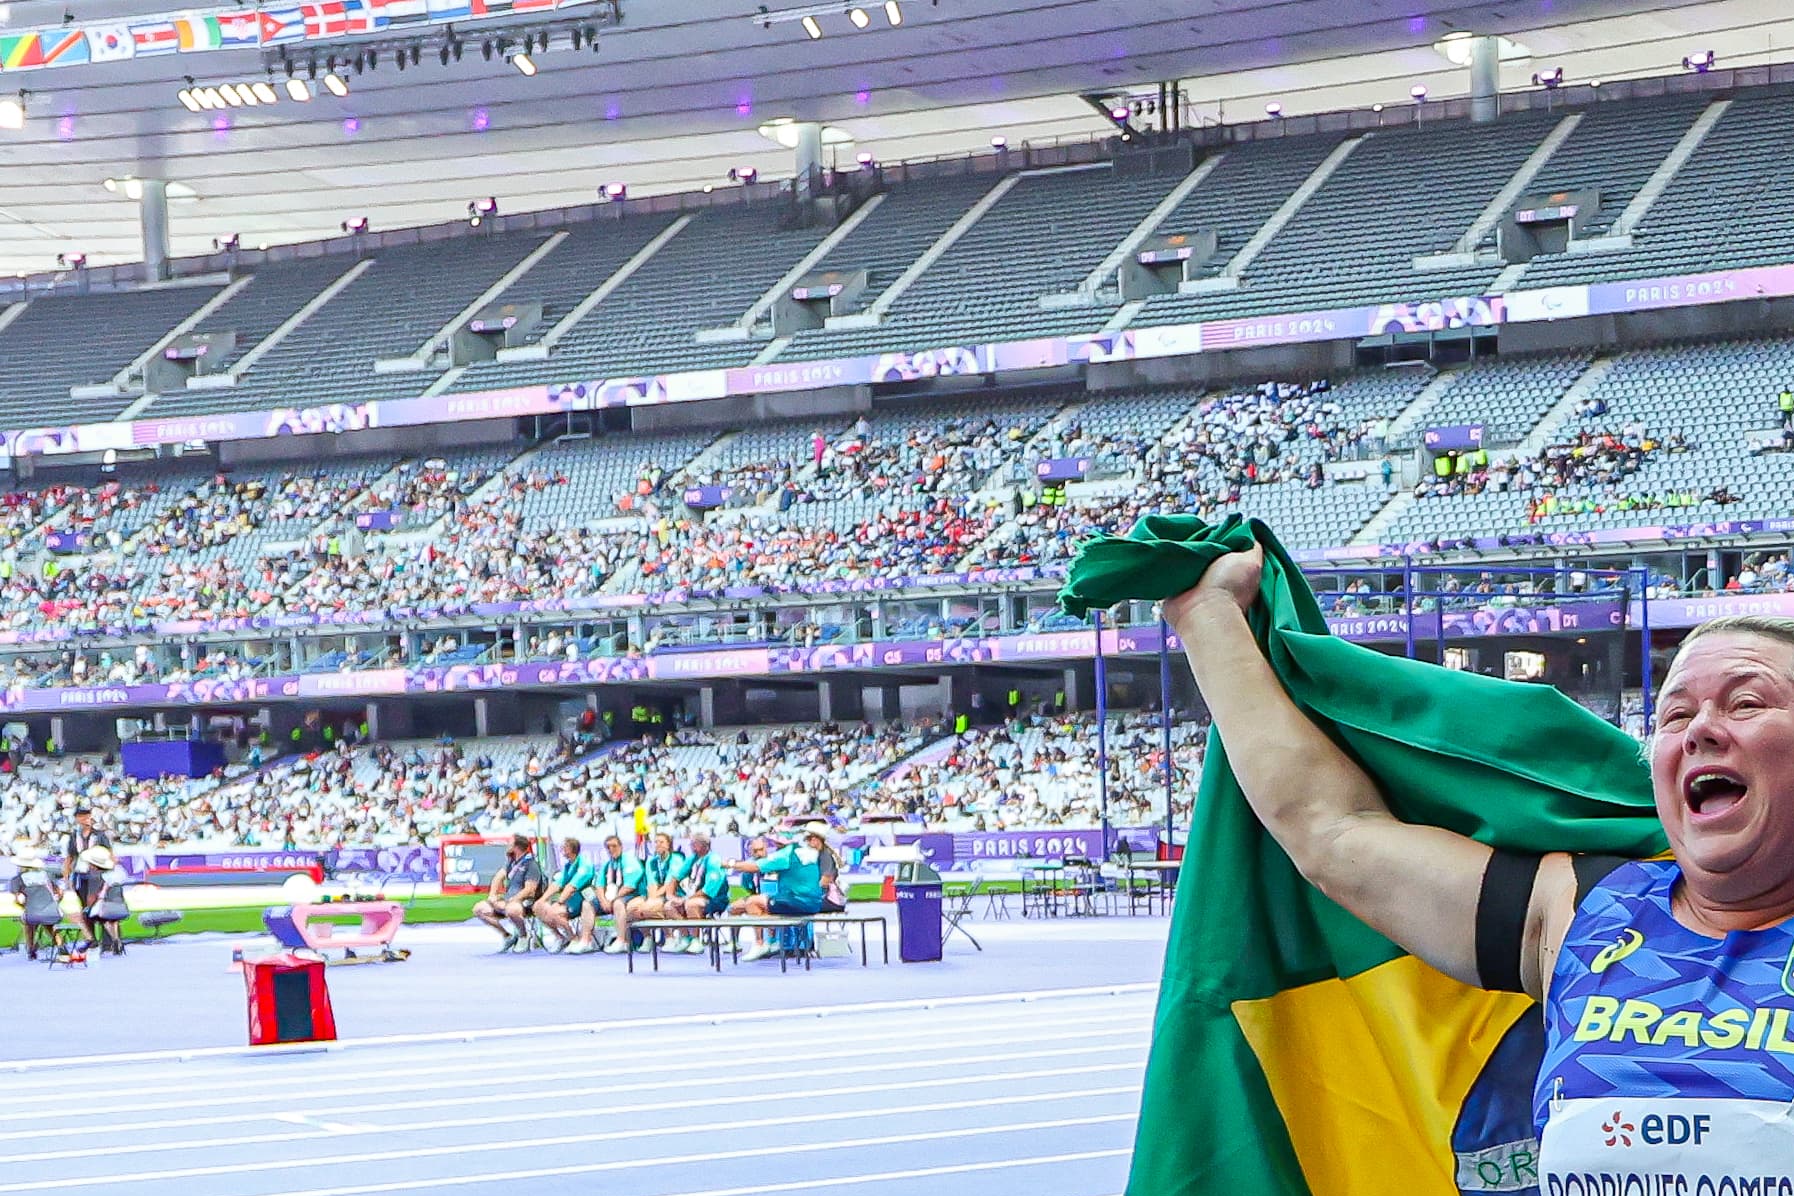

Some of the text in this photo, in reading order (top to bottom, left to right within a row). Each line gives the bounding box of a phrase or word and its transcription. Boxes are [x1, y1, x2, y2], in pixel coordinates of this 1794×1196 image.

[1626, 279, 1735, 303] PARIS 2024
[1233, 319, 1336, 339] PARIS 2024
[1686, 601, 1782, 617] PARIS 2024
[1367, 619, 1407, 633] 2024
[1017, 637, 1057, 653] PARIS
[972, 837, 1087, 856] PARIS 2024
